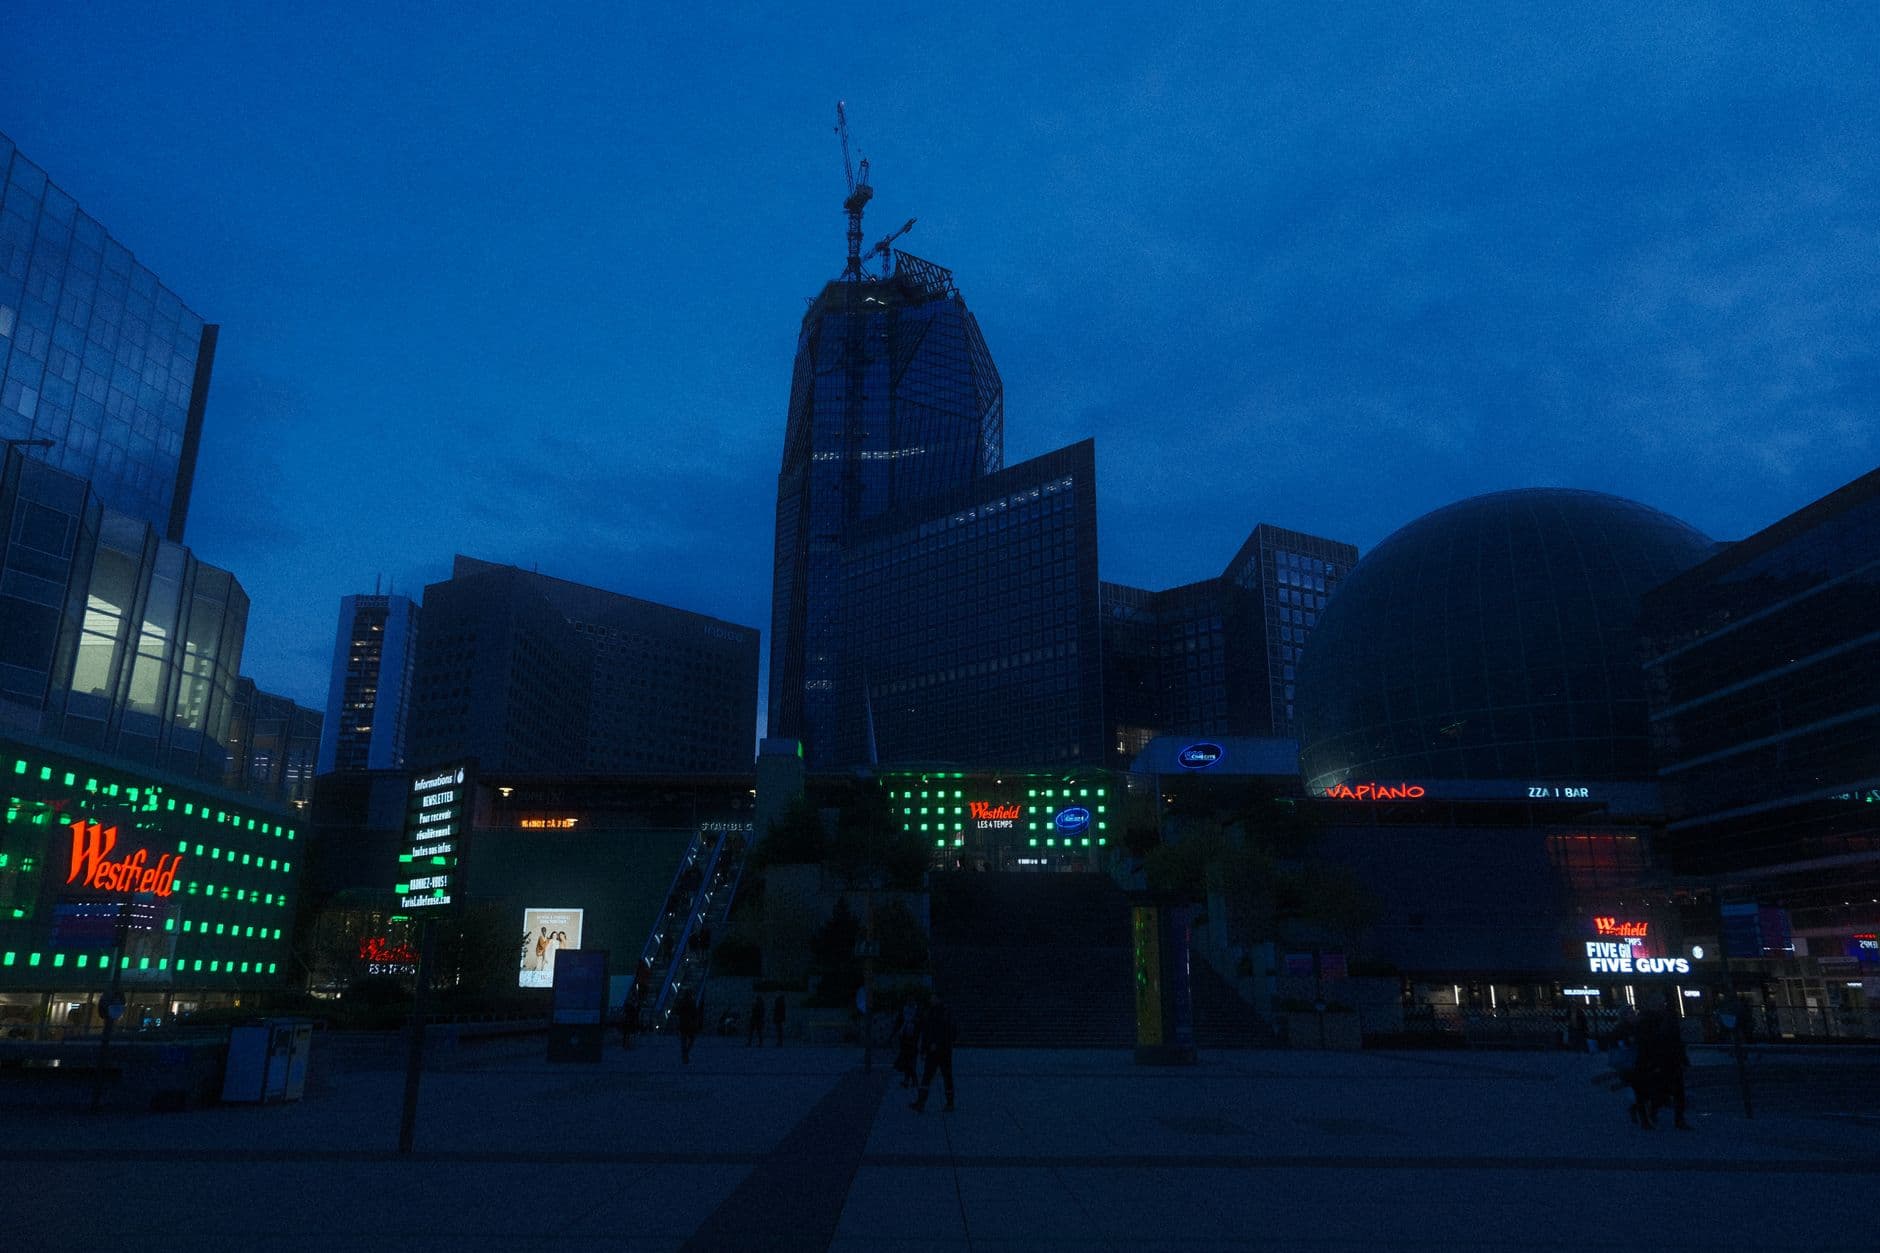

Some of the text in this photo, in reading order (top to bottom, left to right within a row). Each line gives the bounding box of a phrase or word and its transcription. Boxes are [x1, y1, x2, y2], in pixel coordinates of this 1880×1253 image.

[414, 774, 453, 791] Informations
[422, 791, 454, 807] NEWSLETTER
[1528, 787, 1550, 798] ZZA
[1564, 787, 1589, 798] BAR
[419, 810, 452, 824] Pour recevoir
[969, 801, 1021, 821] Westfield
[977, 820, 1013, 829] LES 4 TEMPS
[65, 819, 183, 898] Westfield
[412, 847, 428, 857] toutes
[1594, 917, 1648, 936] Westfield
[1586, 942, 1618, 958] FIVE
[1590, 958, 1690, 973] FIVE GUYS
